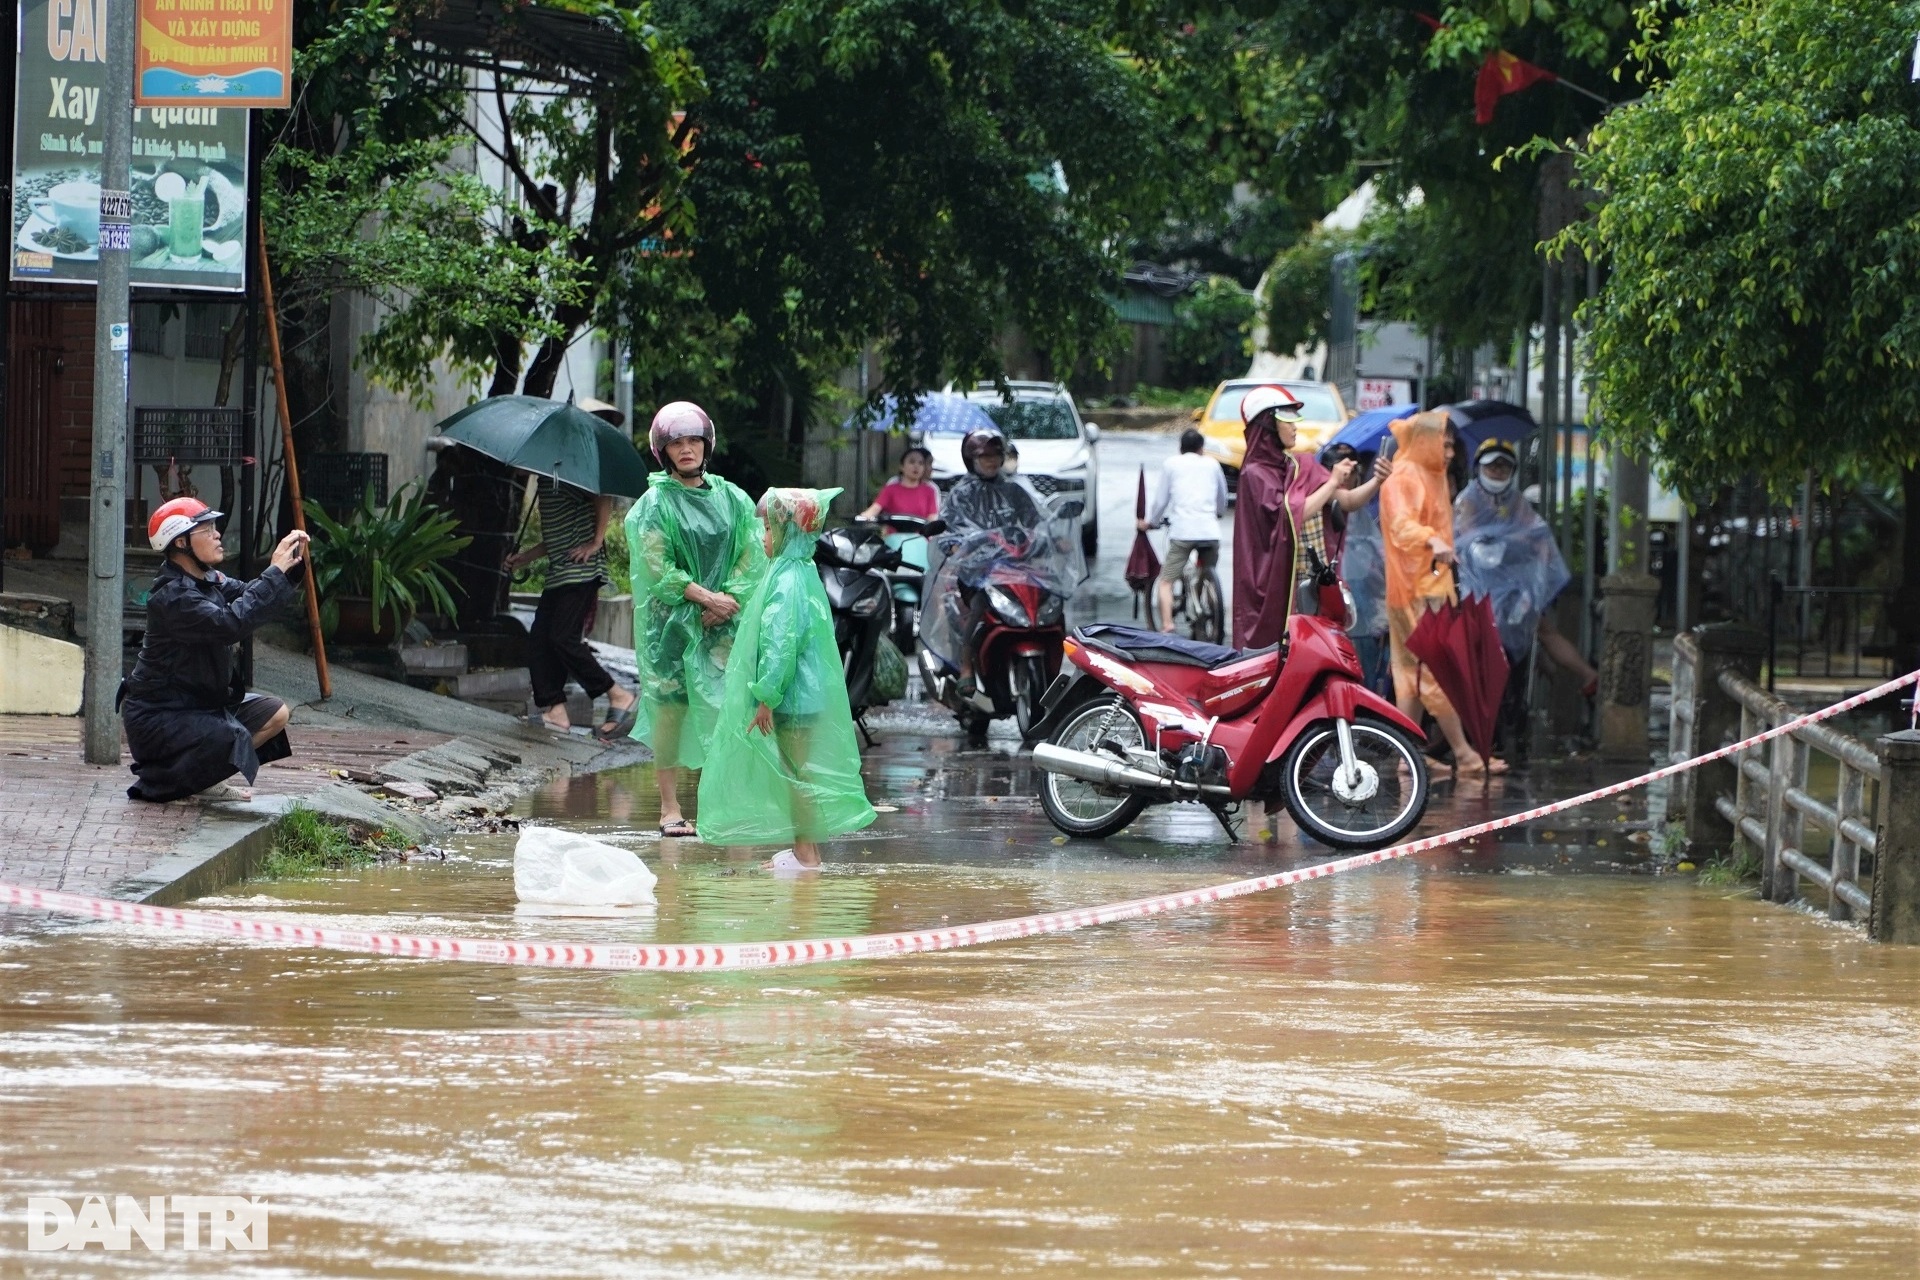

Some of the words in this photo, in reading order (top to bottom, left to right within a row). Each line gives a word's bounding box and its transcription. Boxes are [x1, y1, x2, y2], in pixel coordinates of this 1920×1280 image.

[180, 0, 214, 11] NINH
[168, 17, 186, 37] VÀ
[190, 17, 218, 37] XÂY
[222, 20, 260, 40] DỰNG
[198, 43, 226, 62] VĂN
[230, 46, 268, 62] MINH
[48, 77, 100, 126] Xay
